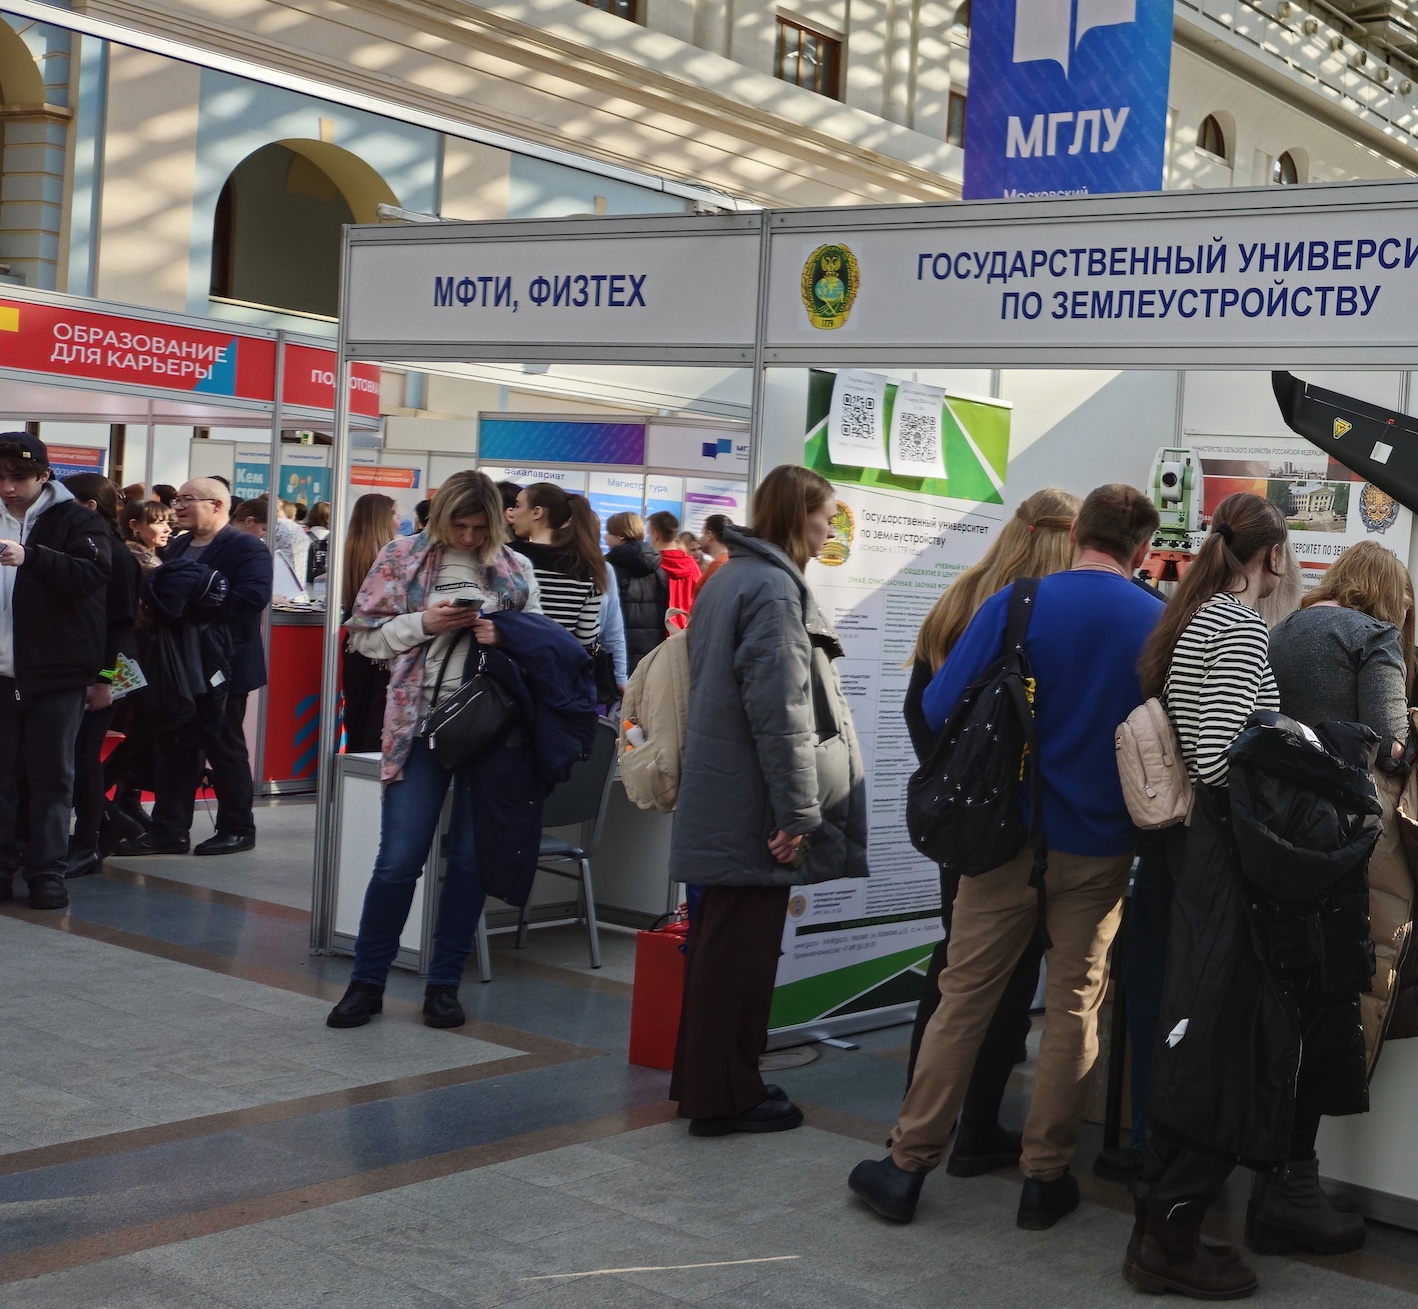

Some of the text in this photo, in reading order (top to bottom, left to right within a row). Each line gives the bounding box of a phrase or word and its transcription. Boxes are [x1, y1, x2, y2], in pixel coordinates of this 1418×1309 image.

[1006, 107, 1130, 158] МГЛУ
[916, 237, 1227, 283] ГОСУДАРСТВЕННЫЙ
[434, 274, 646, 313] МФТИ, ФИЗТЕХ
[1000, 280, 1381, 320] ПО ЗЕМЛЕУСТРОЙСТВУ
[53, 322, 228, 363] ОБРАЗОВАНИЕ
[50, 343, 213, 380] ДЛЯ КАРЬЕРЫ
[236, 468, 264, 484] Кем
[504, 467, 566, 481] Бакалавриат
[607, 478, 668, 493] Магистртура
[861, 510, 989, 534] Государственный университет
[860, 528, 946, 548] по землеустройству
[1292, 542, 1321, 556] ЕРСИТЕТ
